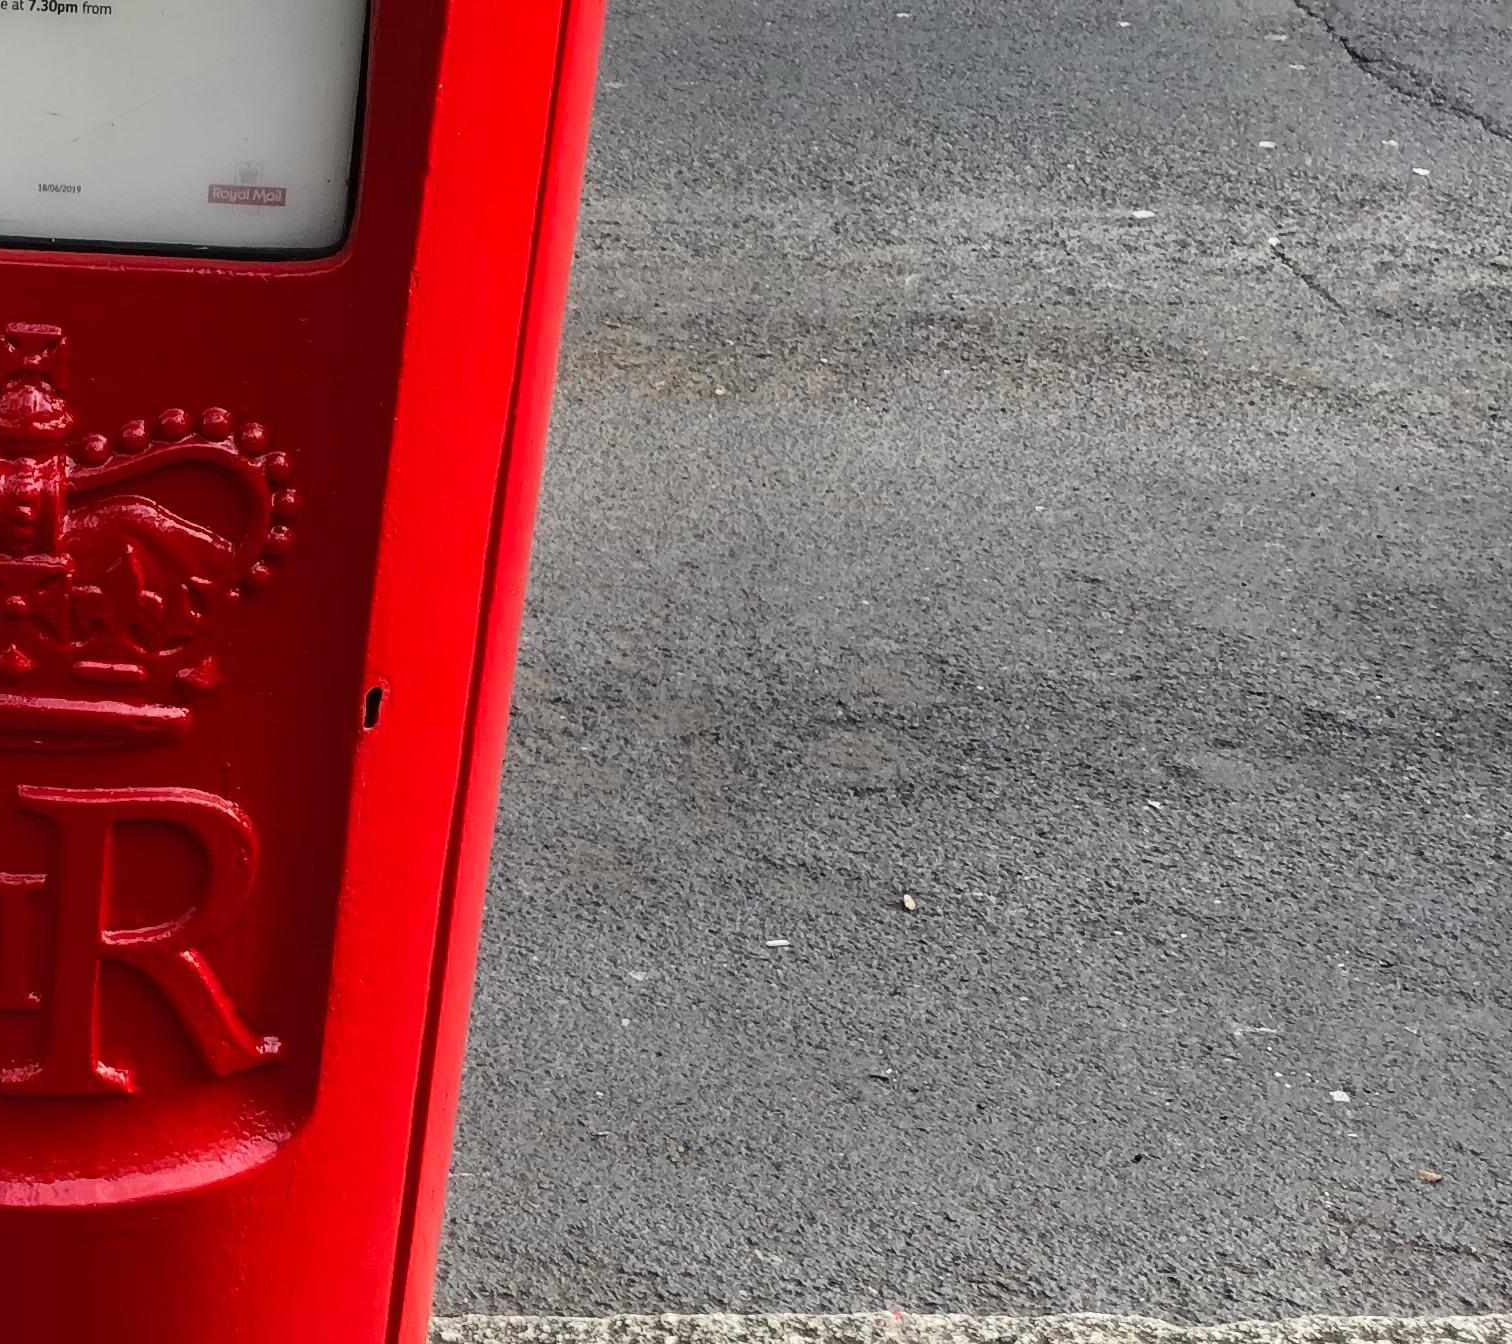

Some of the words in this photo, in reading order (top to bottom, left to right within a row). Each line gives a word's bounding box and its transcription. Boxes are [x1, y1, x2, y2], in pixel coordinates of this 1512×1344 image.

[12, 0, 25, 11] at
[82, 1, 112, 15] from
[212, 186, 250, 203] Royal
[252, 188, 283, 204] Mail
